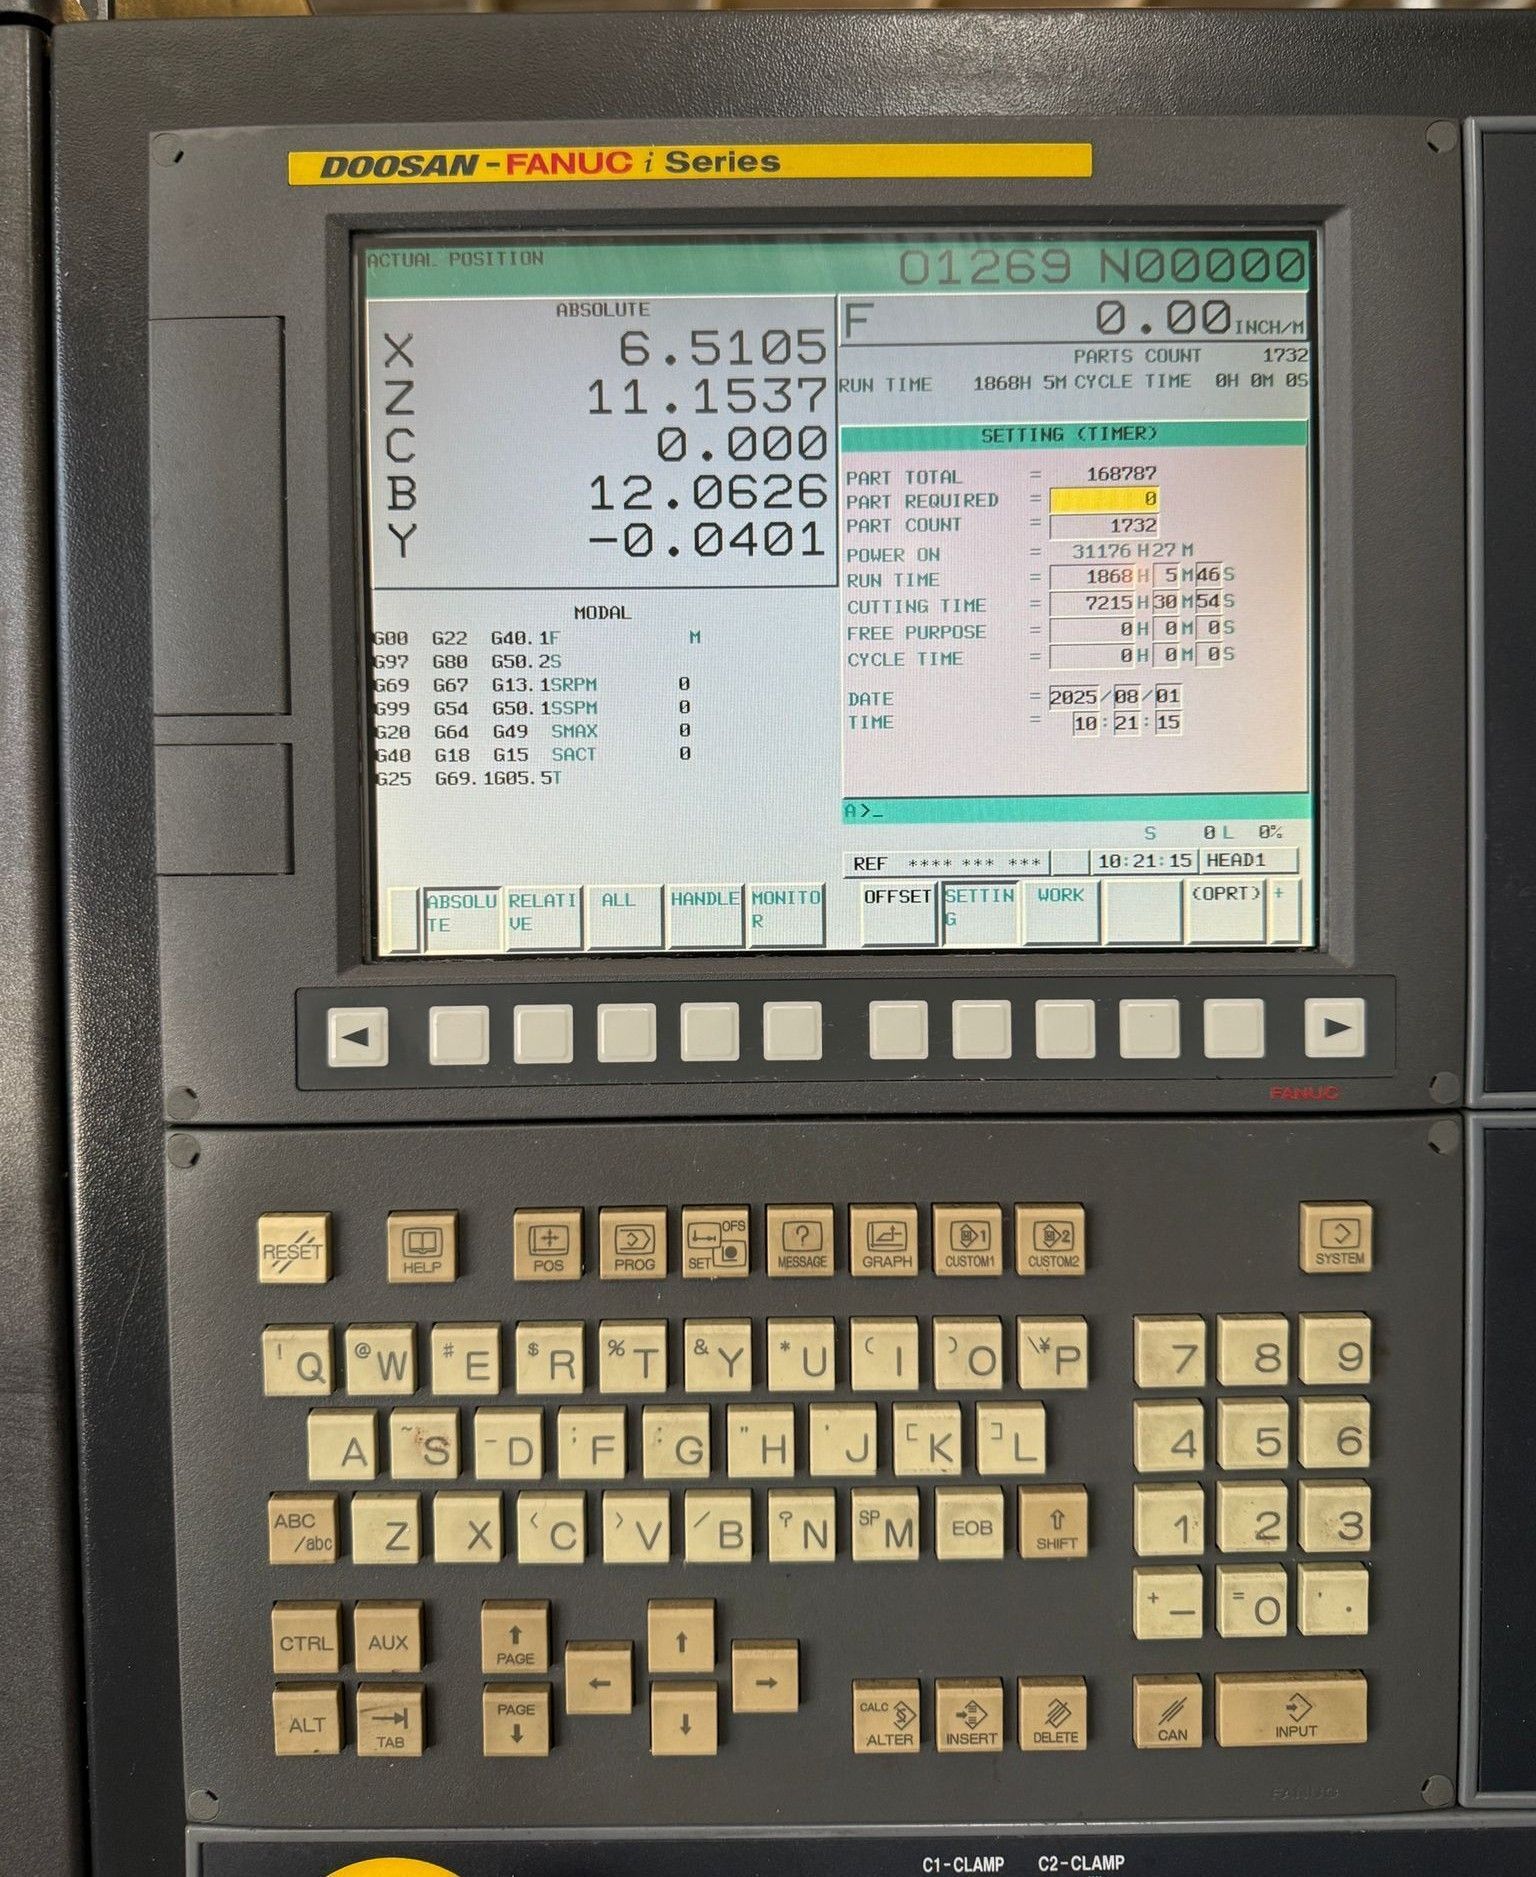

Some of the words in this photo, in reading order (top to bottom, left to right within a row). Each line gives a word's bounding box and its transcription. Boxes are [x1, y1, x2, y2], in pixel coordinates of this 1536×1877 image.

[665, 151, 781, 173] Series
[367, 253, 437, 268] ACTUAL
[449, 251, 544, 266] POSITION
[1101, 248, 1305, 283] N00000
[556, 302, 650, 317] ABSOLUTE
[846, 303, 874, 338] F
[1097, 300, 1230, 335] 0.00
[1235, 320, 1304, 335] INCH/M
[383, 333, 414, 368] X
[620, 330, 827, 367] 6.5105
[1074, 348, 1133, 363] PARTS
[1145, 348, 1201, 363] COUNT
[1263, 348, 1308, 363] 1732
[839, 378, 874, 392] RUN
[886, 377, 932, 391] TIME
[974, 376, 1031, 391] 1868H
[1074, 375, 1132, 389] CYCLE
[1146, 374, 1191, 389] TIME
[385, 381, 415, 415] Z
[589, 379, 828, 414] 11.1537
[982, 428, 1064, 443] SETTING
[1078, 426, 1158, 442] (TIMER)
[387, 428, 416, 463] C
[658, 426, 827, 462] 0.000
[846, 470, 891, 485] PART
[905, 469, 962, 484] TOTAL
[1087, 467, 1157, 481] 168787
[388, 475, 417, 510] B
[590, 474, 828, 510] 12.0626
[846, 494, 891, 508] PART
[905, 493, 999, 508] REQUIRED
[847, 518, 891, 532] PART
[905, 517, 962, 532] COUNT
[1110, 518, 1157, 533] 1732
[388, 523, 417, 558] Y
[590, 522, 825, 557] -0.0401
[847, 548, 904, 563] POWER
[917, 547, 940, 562] ON
[1072, 544, 1131, 559] 31176
[847, 573, 883, 588] RUN
[894, 572, 939, 587] TIME
[1087, 568, 1133, 584] 1868
[847, 599, 929, 614] CUTTING
[942, 598, 987, 613] TIME
[1086, 595, 1132, 611] 7215
[574, 606, 632, 620] MODAL
[374, 631, 408, 646] G00
[432, 631, 467, 645] G22
[847, 626, 894, 641] FREE
[905, 625, 987, 639] PURPOSE
[374, 655, 409, 669] G97
[433, 655, 468, 669] G80
[848, 652, 905, 667] CYCLE
[918, 652, 963, 666] TIME
[374, 678, 409, 693] G69
[433, 678, 468, 692] G67
[552, 678, 597, 691] SRPM
[849, 692, 894, 706] DATE
[375, 702, 410, 716] G99
[434, 701, 468, 715] G54
[552, 701, 597, 715] SSPM
[849, 715, 894, 730] TIME
[375, 725, 410, 740] G20
[434, 725, 469, 739] G64
[493, 724, 528, 739] G49
[552, 724, 598, 738] SMAX
[376, 748, 411, 763] G40
[435, 748, 470, 762] G18
[494, 748, 528, 762] G15
[552, 748, 596, 761] SACT
[377, 772, 411, 786] G25
[854, 856, 887, 871] REF
[1099, 853, 1192, 868] 10:21:15
[1207, 853, 1266, 867] HEAD1
[426, 894, 496, 909] ABSOLU
[509, 894, 576, 908] RELATI
[602, 893, 636, 907] ALL
[671, 892, 740, 906] HANDLE
[752, 891, 820, 905] MONITO
[864, 889, 931, 904] OFFSET
[945, 889, 1014, 903] SETTIN
[1038, 888, 1084, 902] WORK
[1193, 886, 1260, 901] (OPRT)
[428, 918, 450, 932] TE
[510, 917, 532, 931] VE
[1270, 1087, 1339, 1100] FANUC
[723, 1221, 746, 1232] OFS
[263, 1244, 322, 1260] RESET
[1316, 1253, 1364, 1264] SYSTEM
[404, 1262, 441, 1274] HELP
[534, 1259, 564, 1272] POS
[615, 1259, 655, 1271] PROG
[689, 1258, 711, 1269] SET
[778, 1256, 827, 1268] MESSAGE
[863, 1256, 912, 1268] GRAPH
[946, 1256, 994, 1267] CUSTOM1
[1028, 1255, 1079, 1267] CUSTOM2
[551, 1350, 575, 1379] R
[634, 1348, 659, 1379] T
[718, 1347, 744, 1378] Y
[803, 1347, 826, 1377] U
[1056, 1346, 1080, 1375] P
[1172, 1344, 1198, 1374] 7
[1255, 1343, 1281, 1373] 8
[1338, 1342, 1363, 1371] 9
[298, 1351, 326, 1384] Q
[378, 1351, 407, 1380] W
[467, 1351, 489, 1380] E
[763, 1435, 786, 1464] H
[931, 1433, 953, 1462] K
[1171, 1429, 1197, 1459] 4
[1256, 1427, 1281, 1456] 5
[1337, 1427, 1362, 1456] 6
[341, 1437, 368, 1467] A
[509, 1436, 533, 1465] D
[592, 1436, 615, 1465] F
[675, 1437, 703, 1465] G
[274, 1513, 315, 1528] ABC
[953, 1520, 992, 1536] EOB
[1255, 1511, 1280, 1540] 2
[1338, 1511, 1363, 1540] 3
[550, 1522, 577, 1550] C
[719, 1521, 744, 1549] B
[803, 1520, 827, 1548] N
[859, 1511, 880, 1526] SP
[885, 1518, 913, 1548] M
[1174, 1515, 1188, 1544] 1
[1037, 1538, 1078, 1550] SHIFT
[280, 1636, 333, 1652] CTRL
[368, 1635, 408, 1651] AUX
[497, 1653, 535, 1665] PAGE
[498, 1704, 535, 1716] PAGE
[860, 1703, 888, 1712] CALC
[289, 1717, 325, 1733] ALT
[1275, 1725, 1318, 1738] INPUT
[377, 1737, 404, 1749] TAB
[867, 1734, 913, 1746] ALTER
[946, 1733, 998, 1745] INSERT
[1034, 1732, 1078, 1744] DELETE
[1158, 1729, 1187, 1741] CAN
[923, 1857, 1004, 1873] C1-CLAMP
[1038, 1855, 1124, 1871] C2-CLAMP
